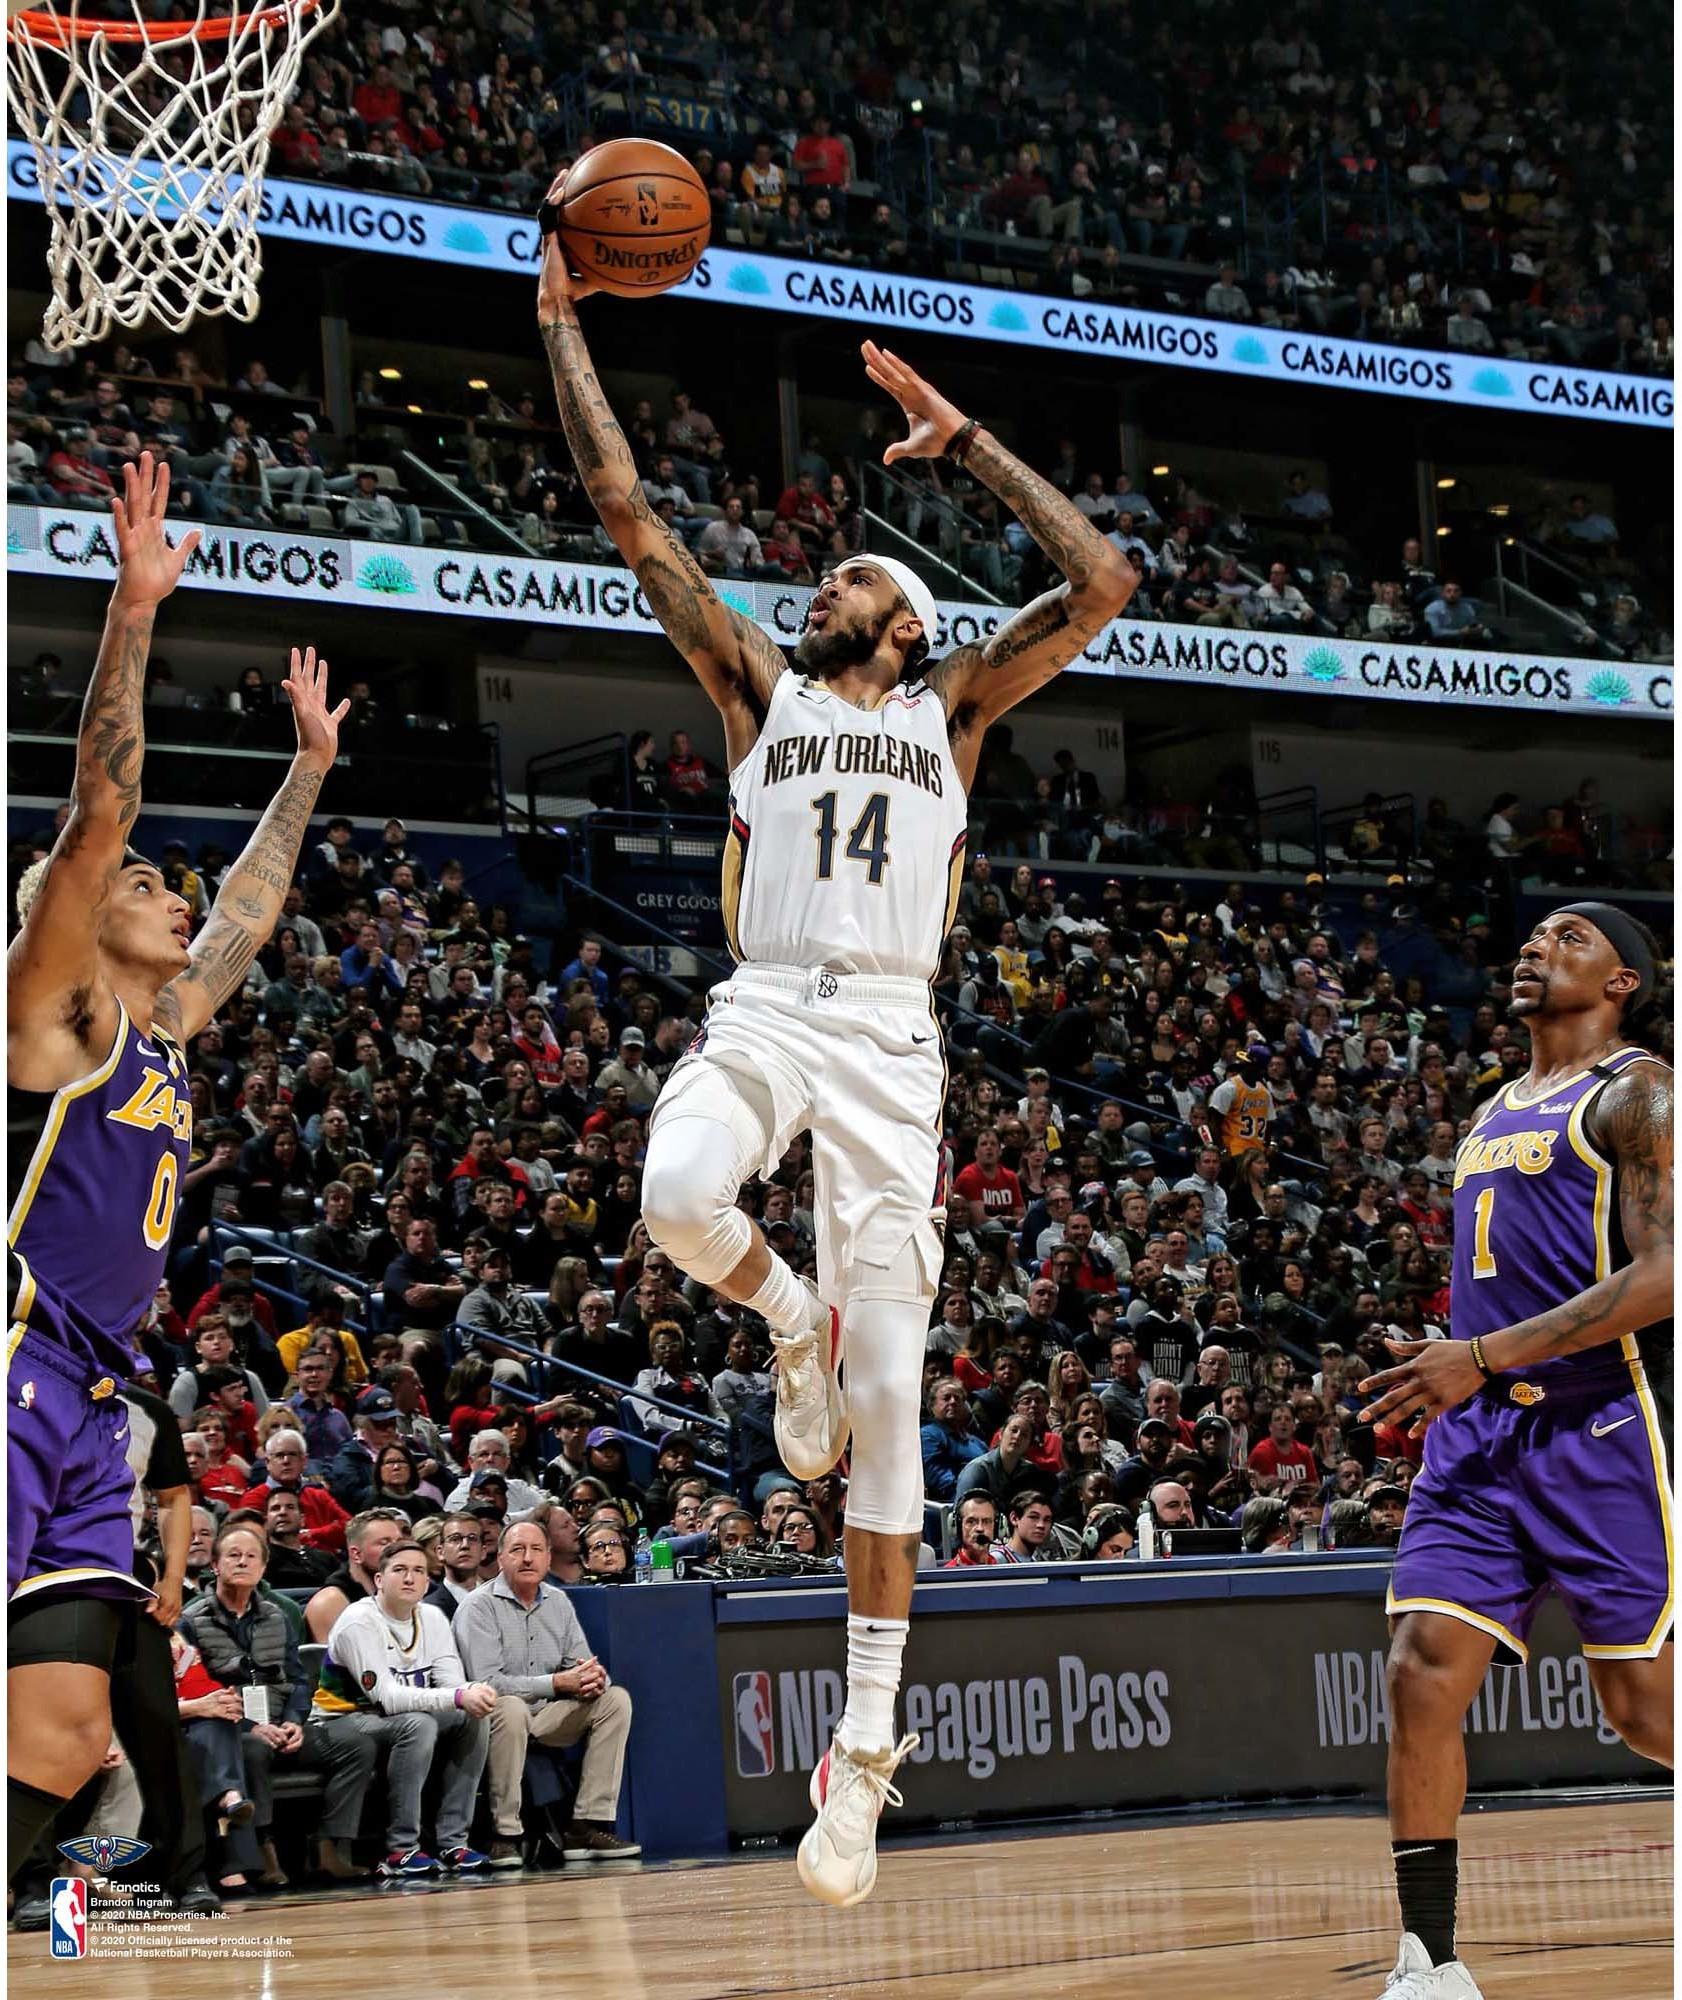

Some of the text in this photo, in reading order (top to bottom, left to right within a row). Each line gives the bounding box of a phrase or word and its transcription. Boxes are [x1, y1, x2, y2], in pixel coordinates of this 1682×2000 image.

[594, 237, 698, 269] SPALDING
[785, 271, 975, 325] CASAMIGOS
[1042, 310, 1219, 359] CASAMIGOS
[1282, 342, 1453, 390] CASAMIGOS
[45, 520, 342, 590] CAMIGOS
[485, 676, 512, 703] 114
[1360, 653, 1571, 700] CASAMIGOS
[1096, 727, 1119, 752] 114
[1259, 736, 1280, 763] 115
[763, 733, 943, 799] NEW ORLEANS
[811, 790, 891, 887] 14
[637, 893, 722, 910] GREY GOOS
[1240, 1115, 1266, 1139] 32
[143, 1151, 177, 1251] 0
[1473, 1187, 1497, 1279] 1
[779, 1655, 1172, 1779] NB eague Pass
